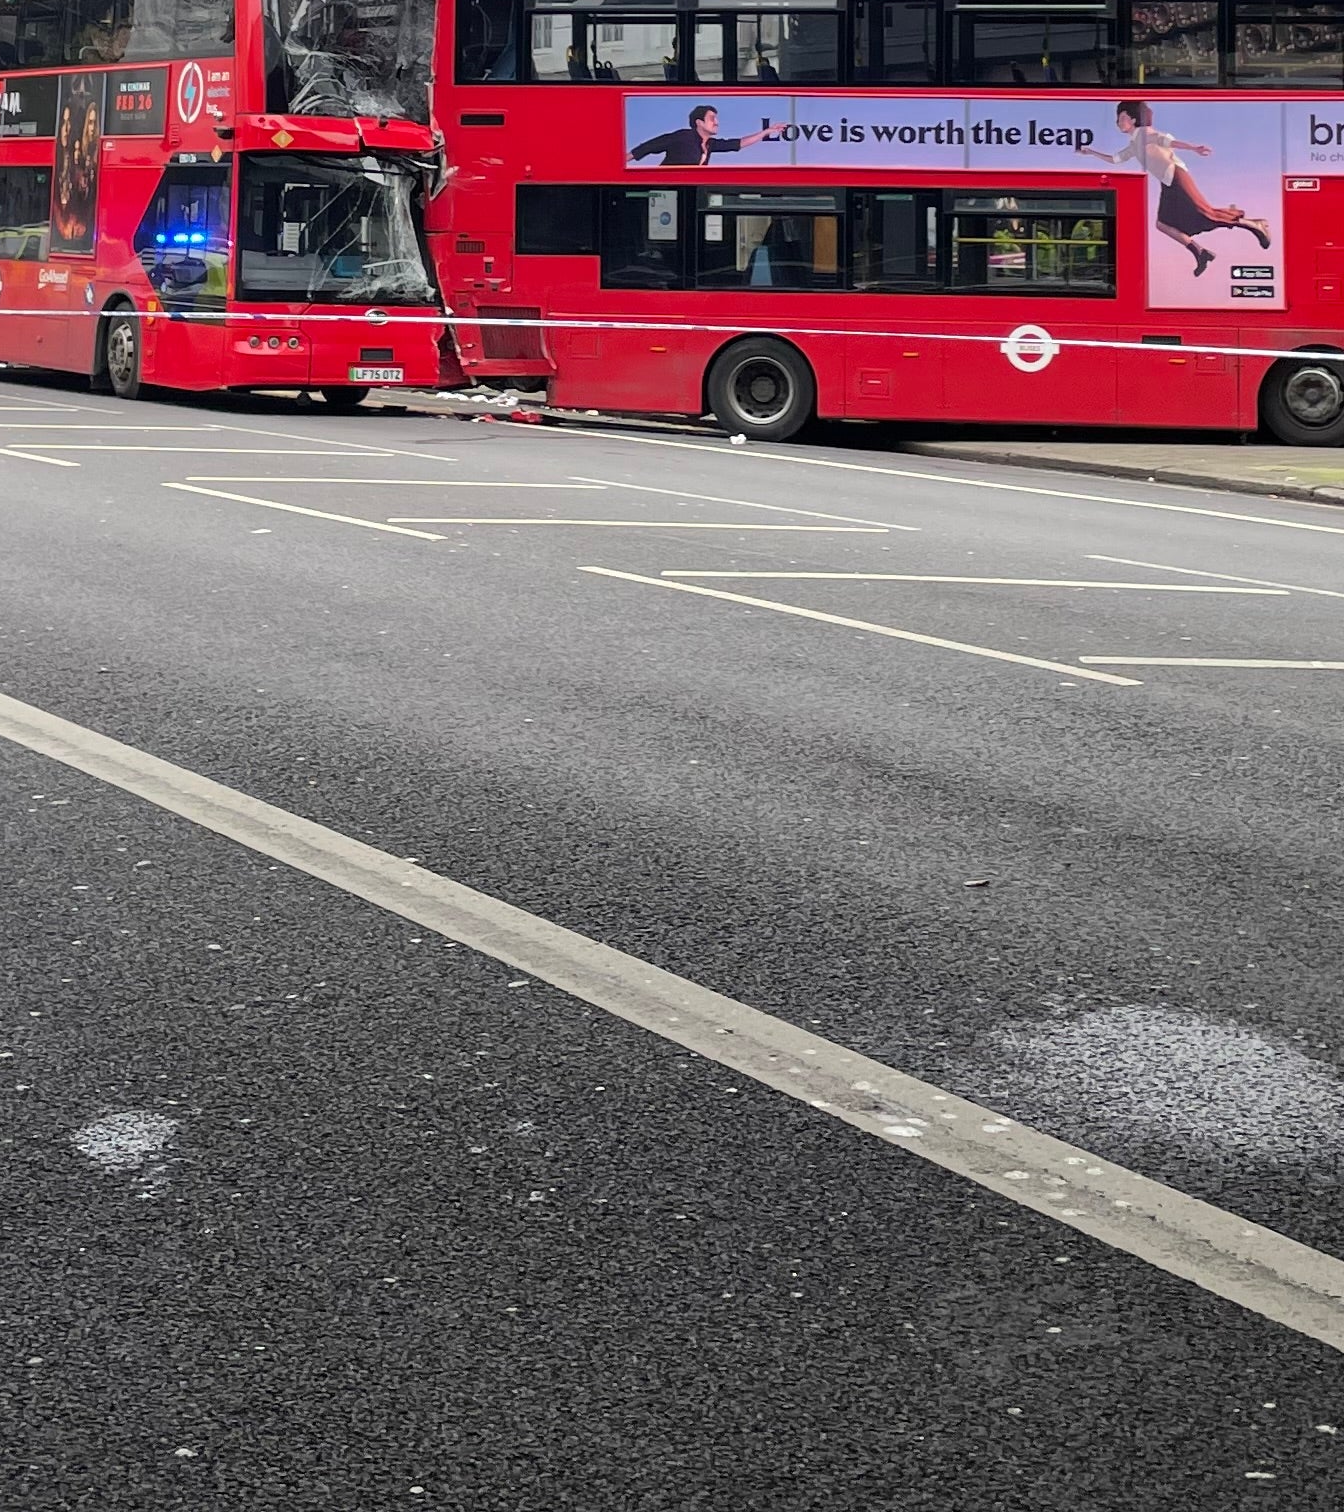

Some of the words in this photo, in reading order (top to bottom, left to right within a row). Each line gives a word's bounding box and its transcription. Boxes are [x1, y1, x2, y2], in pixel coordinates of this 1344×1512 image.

[116, 94, 135, 111] FEB
[137, 93, 153, 110] 26
[761, 117, 834, 143] Love
[840, 117, 865, 143] is
[871, 118, 965, 145] worth
[971, 118, 1022, 145] the
[1028, 119, 1095, 151] leap
[1310, 152, 1327, 162] No
[356, 369, 380, 380] LF75
